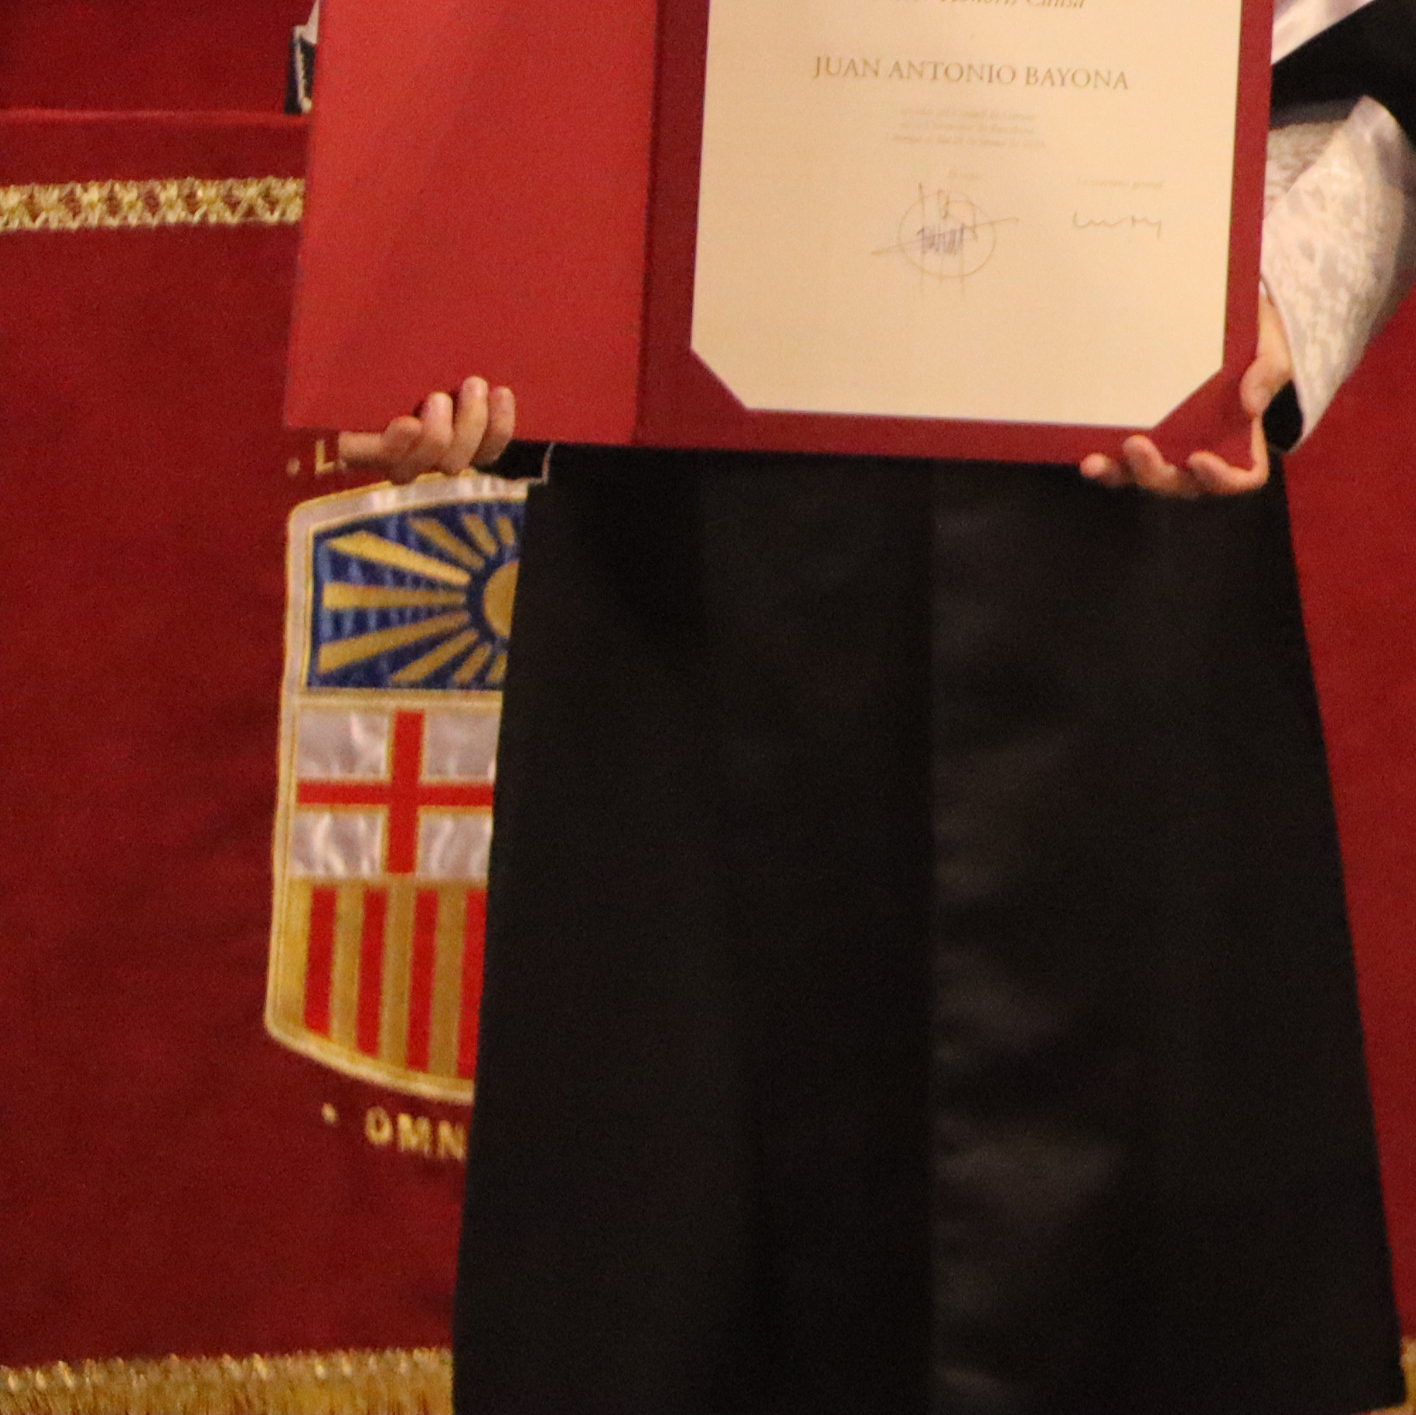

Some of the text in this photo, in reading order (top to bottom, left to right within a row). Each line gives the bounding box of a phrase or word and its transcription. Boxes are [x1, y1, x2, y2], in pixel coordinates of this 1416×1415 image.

[812, 55, 1130, 92] JUAN ANTONIO BAYONA
